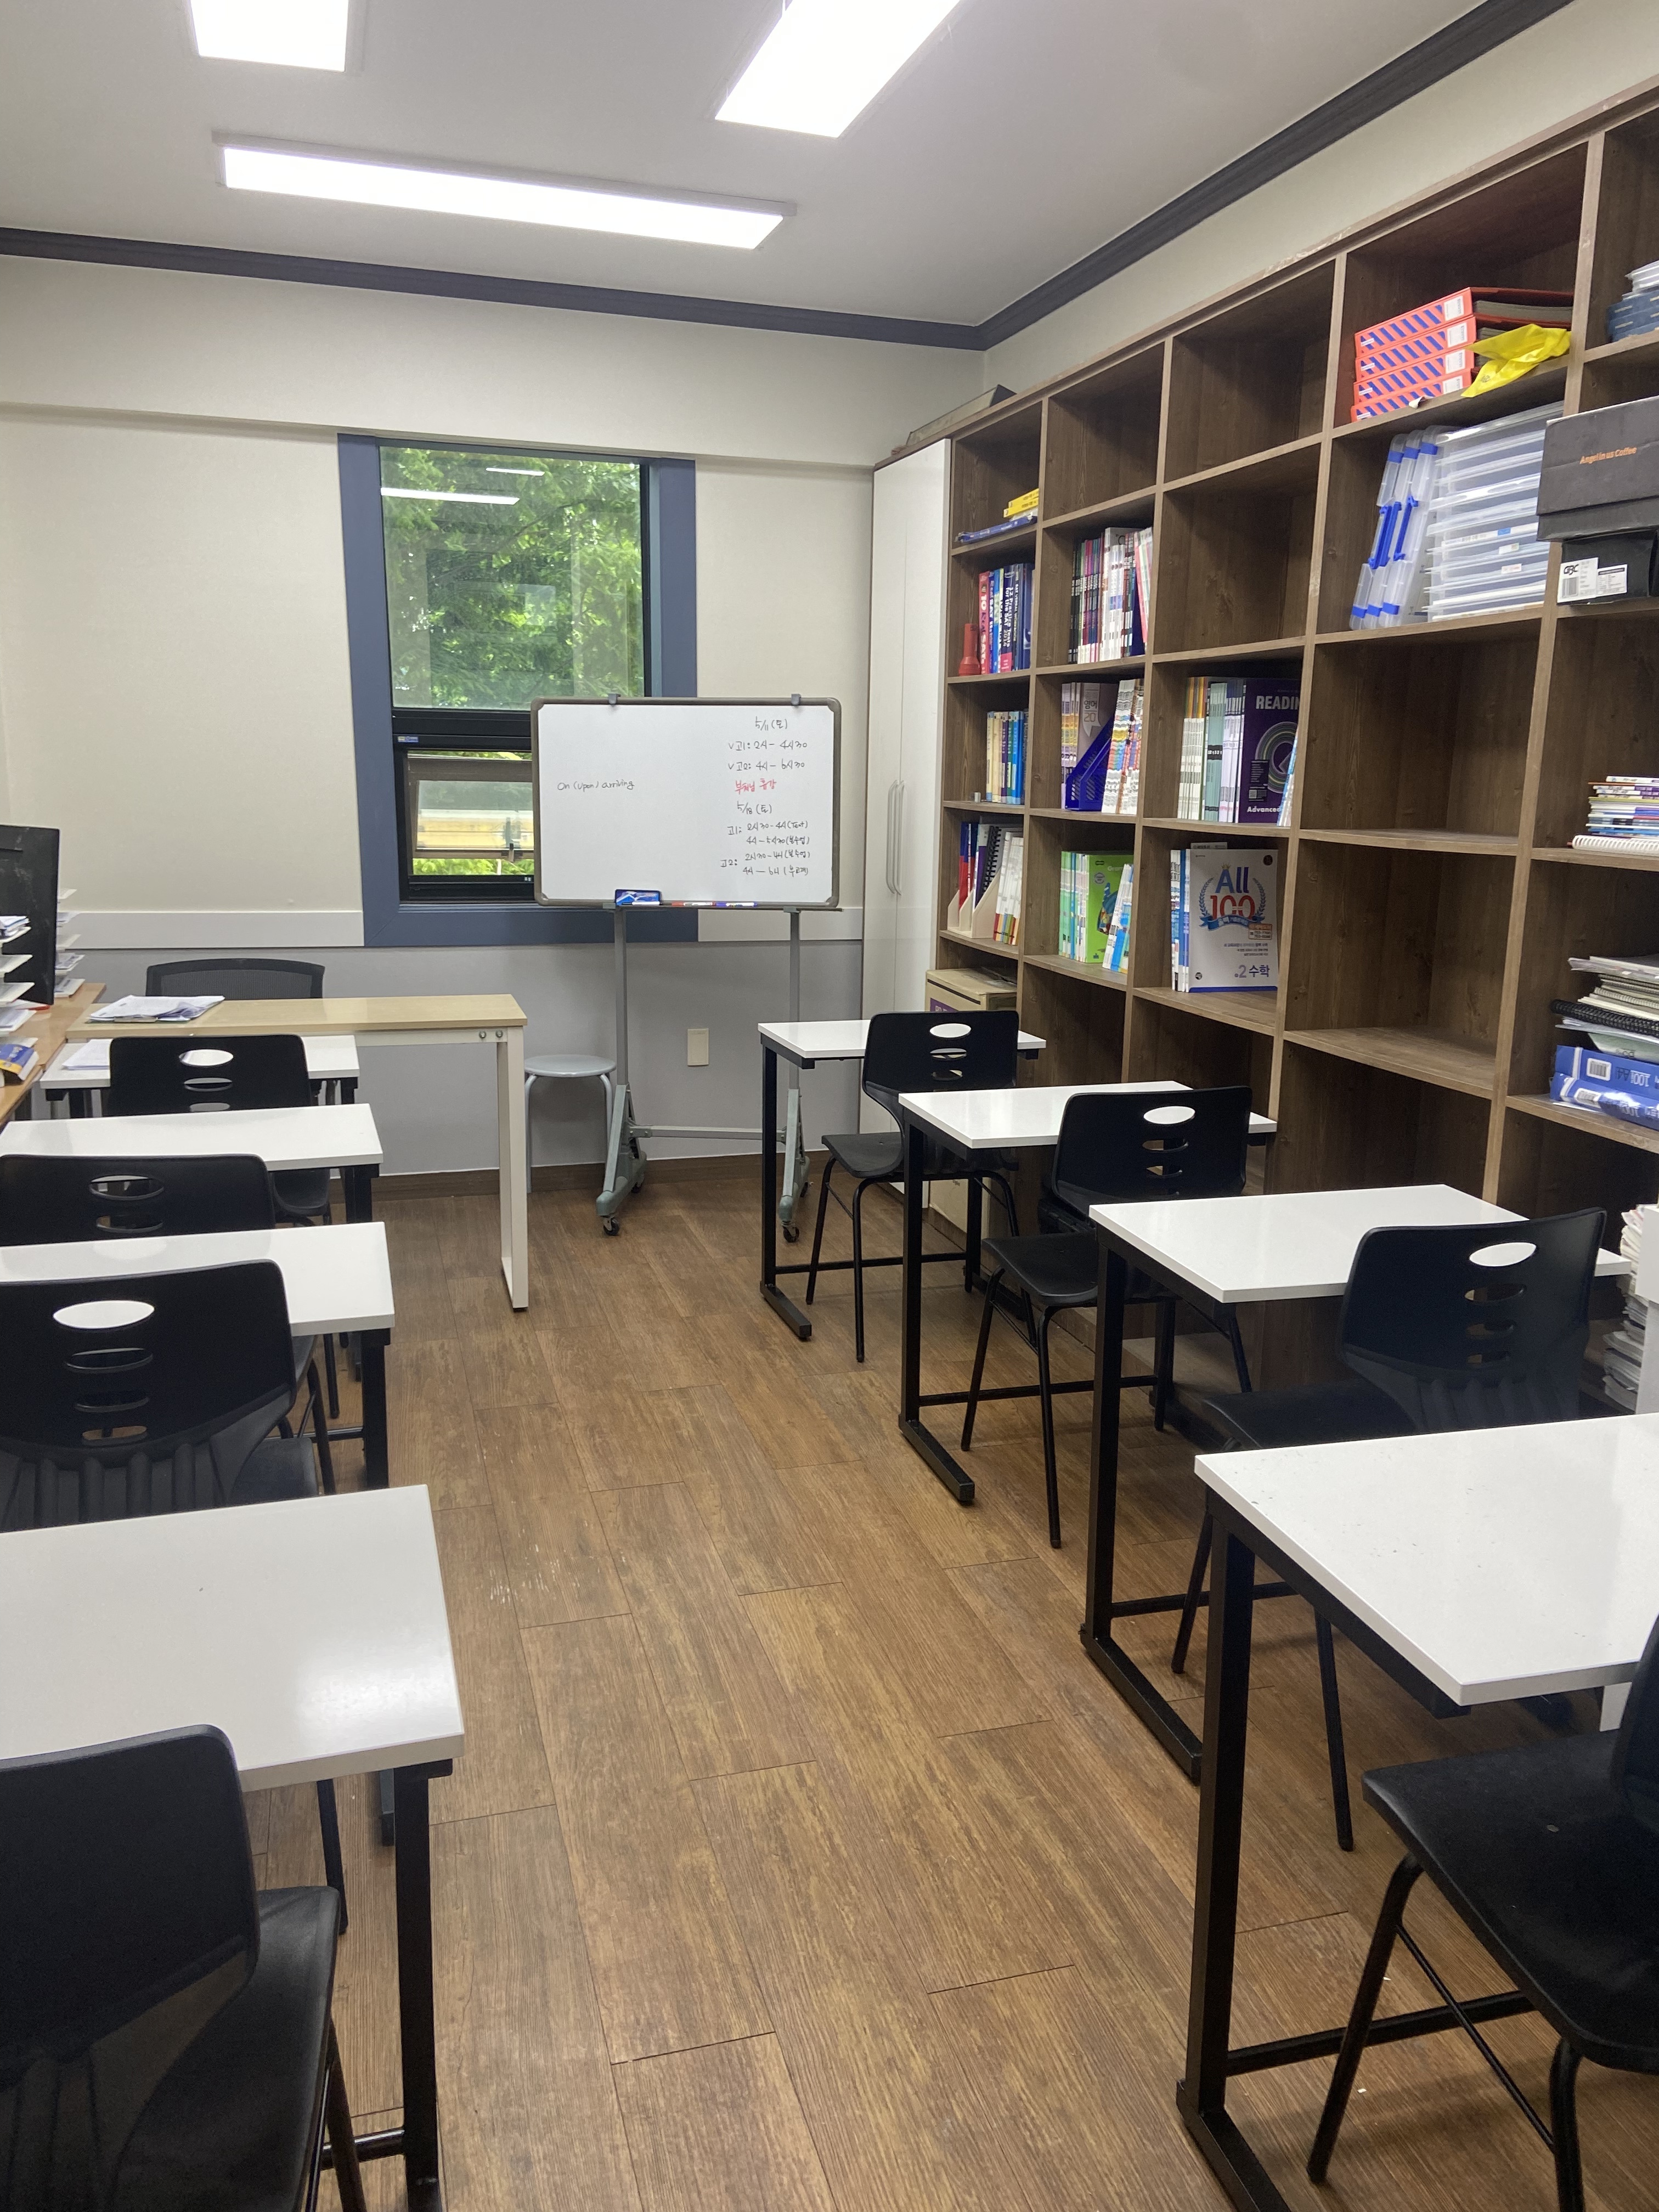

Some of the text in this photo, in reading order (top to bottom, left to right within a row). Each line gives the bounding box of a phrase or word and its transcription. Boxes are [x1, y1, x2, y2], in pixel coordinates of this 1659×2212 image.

[1615, 447, 1637, 457] Coffee
[1084, 700, 1098, 709] 영어
[1084, 712, 1096, 723] 20
[557, 782, 570, 791] On
[601, 779, 635, 790] arriving
[735, 780, 755, 795] 부처님
[737, 800, 753, 815] 5/18
[1215, 866, 1250, 894] All
[1210, 895, 1256, 921] 100
[1248, 964, 1270, 978] 수학
